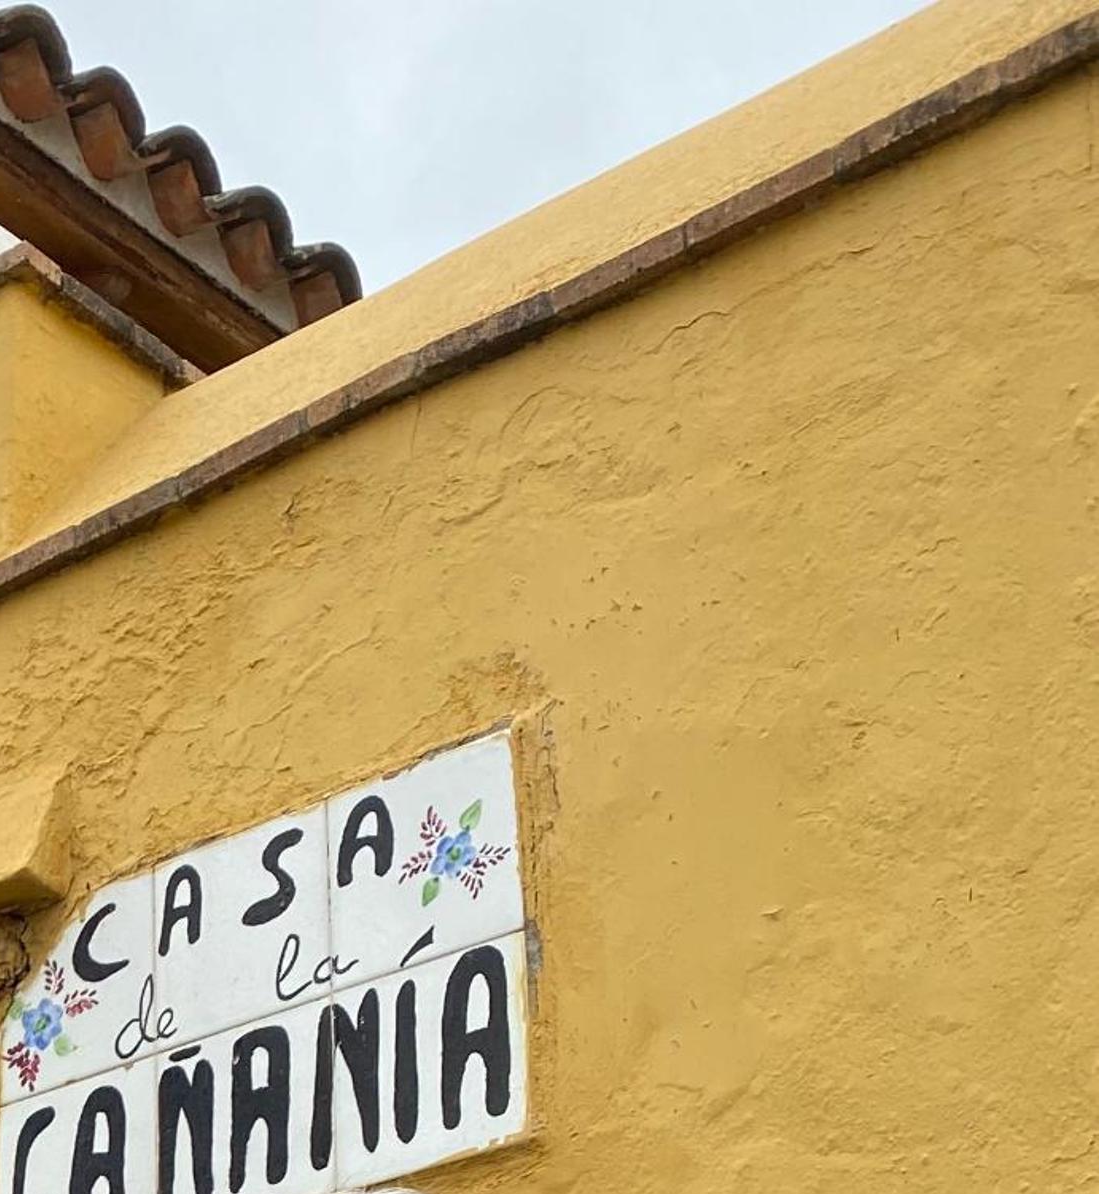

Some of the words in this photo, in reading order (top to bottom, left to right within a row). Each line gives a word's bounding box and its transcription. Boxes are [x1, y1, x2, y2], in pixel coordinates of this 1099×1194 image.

[72, 795, 394, 982] CASA
[114, 974, 178, 1059] de
[275, 934, 359, 1000] la
